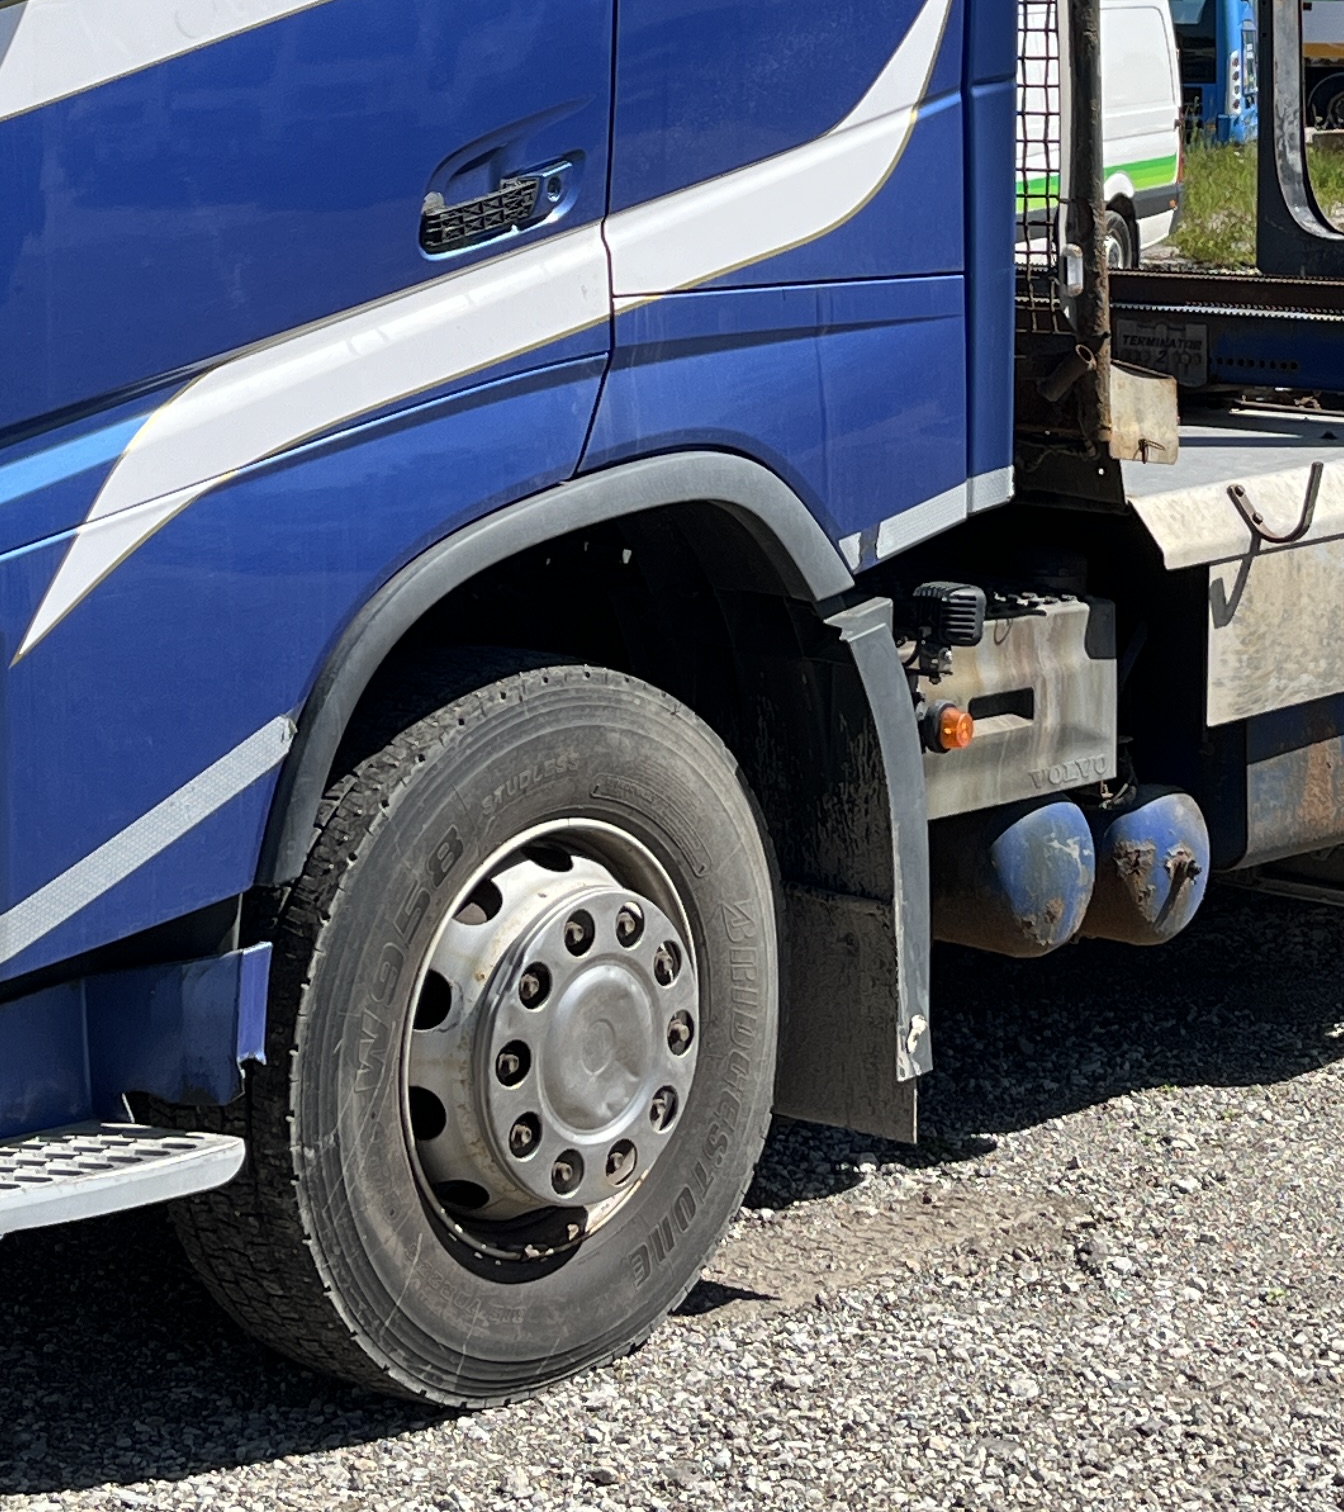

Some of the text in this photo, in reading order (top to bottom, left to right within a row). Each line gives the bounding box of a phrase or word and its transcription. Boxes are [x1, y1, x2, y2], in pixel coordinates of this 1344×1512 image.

[1122, 334, 1203, 350] TERMINATOR
[481, 751, 581, 816] STUDLESS
[1027, 752, 1108, 789] VOLVO
[354, 823, 465, 1093] W958
[629, 899, 758, 1288] BRIDGESTONE
